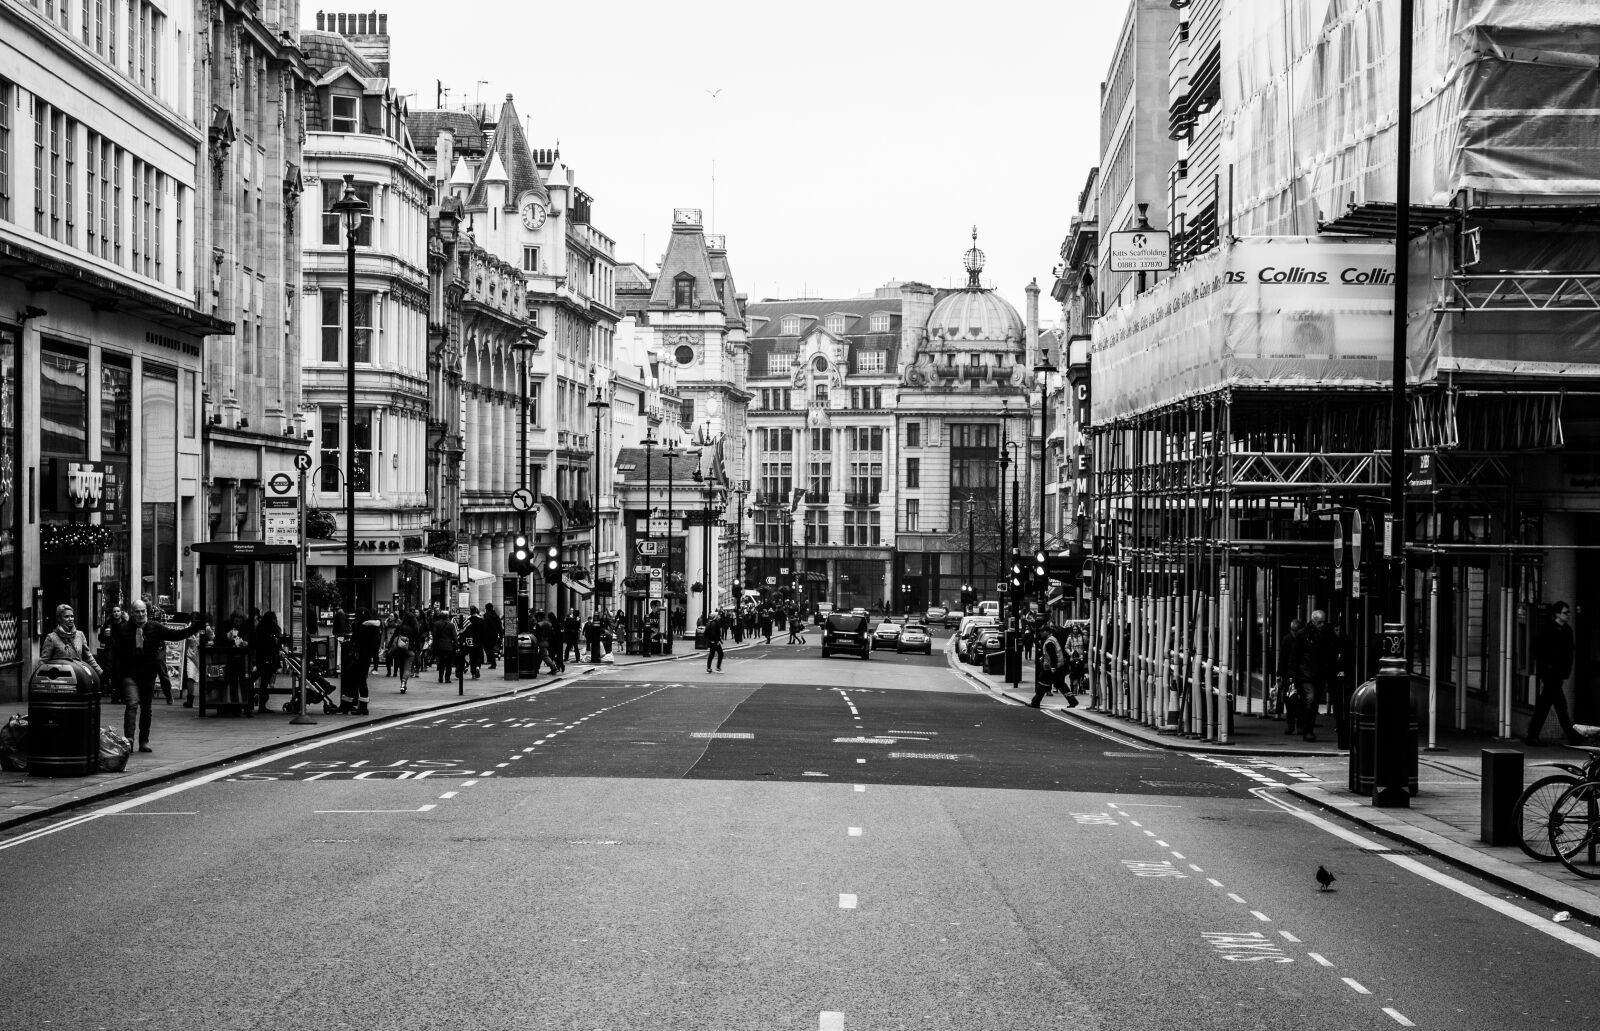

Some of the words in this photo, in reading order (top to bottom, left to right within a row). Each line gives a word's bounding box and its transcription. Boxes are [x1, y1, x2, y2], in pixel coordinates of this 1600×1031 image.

[1129, 248, 1168, 258] Scaffolding
[1117, 261, 1137, 269] 01883
[1258, 267, 1328, 283] Collins
[1340, 267, 1396, 284] Collin
[1076, 384, 1087, 516] CINEMA
[299, 455, 308, 468] R
[184, 546, 190, 557] 8
[288, 759, 464, 769] BUS
[227, 769, 477, 782] STOP
